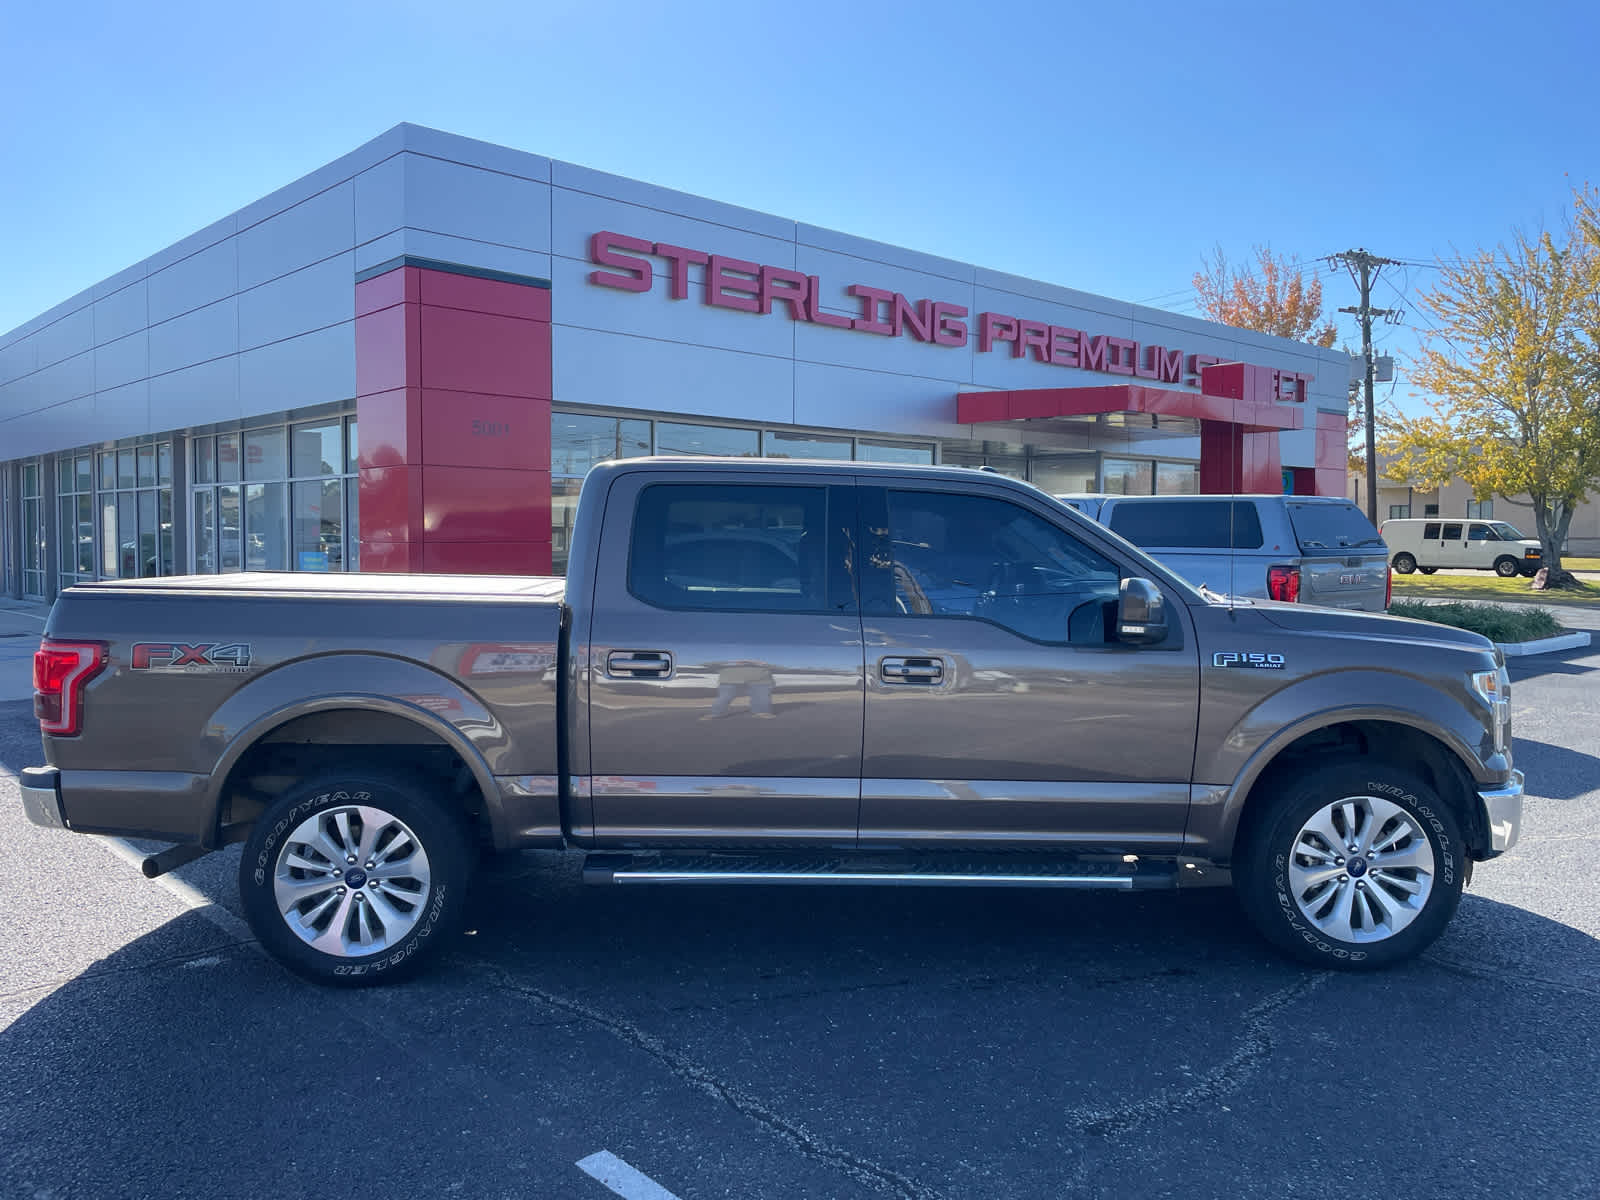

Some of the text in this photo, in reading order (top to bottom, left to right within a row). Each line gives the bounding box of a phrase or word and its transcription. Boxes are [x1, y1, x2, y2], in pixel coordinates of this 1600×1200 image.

[589, 230, 968, 347] STERLING
[979, 312, 1184, 383] PREMIUM
[130, 641, 252, 670] FX4
[255, 791, 371, 886] GOODYEAR
[1367, 782, 1453, 885] WRANGLER
[333, 885, 447, 976] WRANGLER
[1276, 854, 1367, 961] GOODYEAR
